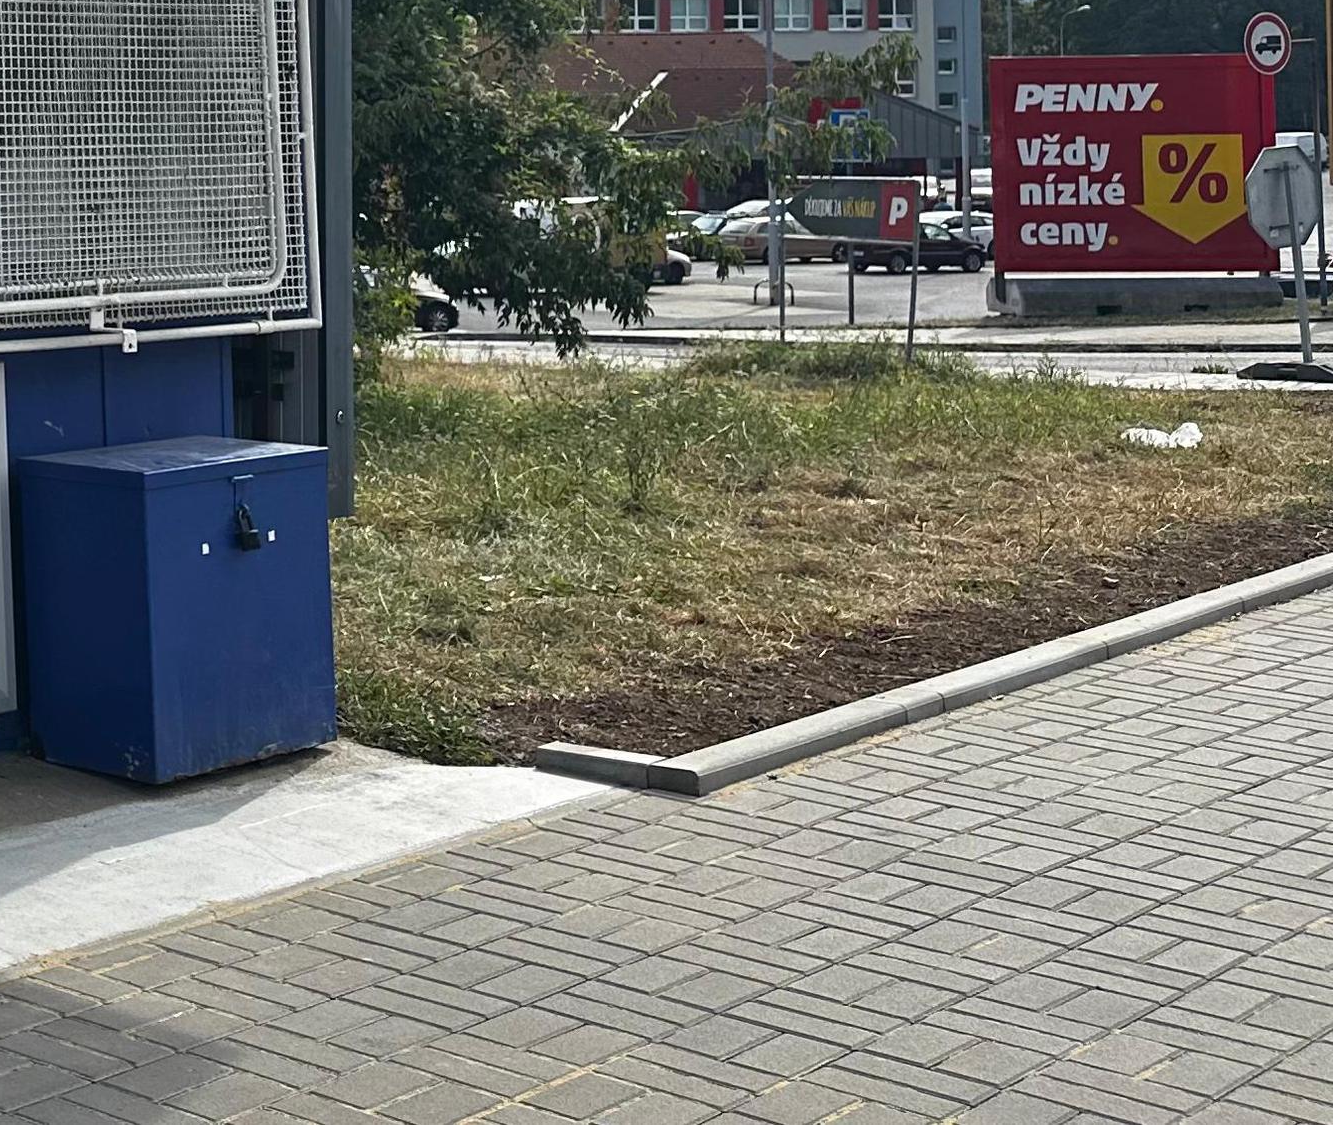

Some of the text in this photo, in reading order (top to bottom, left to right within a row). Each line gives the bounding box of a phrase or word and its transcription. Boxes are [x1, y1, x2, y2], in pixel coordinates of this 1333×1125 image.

[1016, 133, 1110, 172] Vždy
[1019, 173, 1125, 206] nízké
[1158, 142, 1229, 203] %
[888, 196, 908, 225] P
